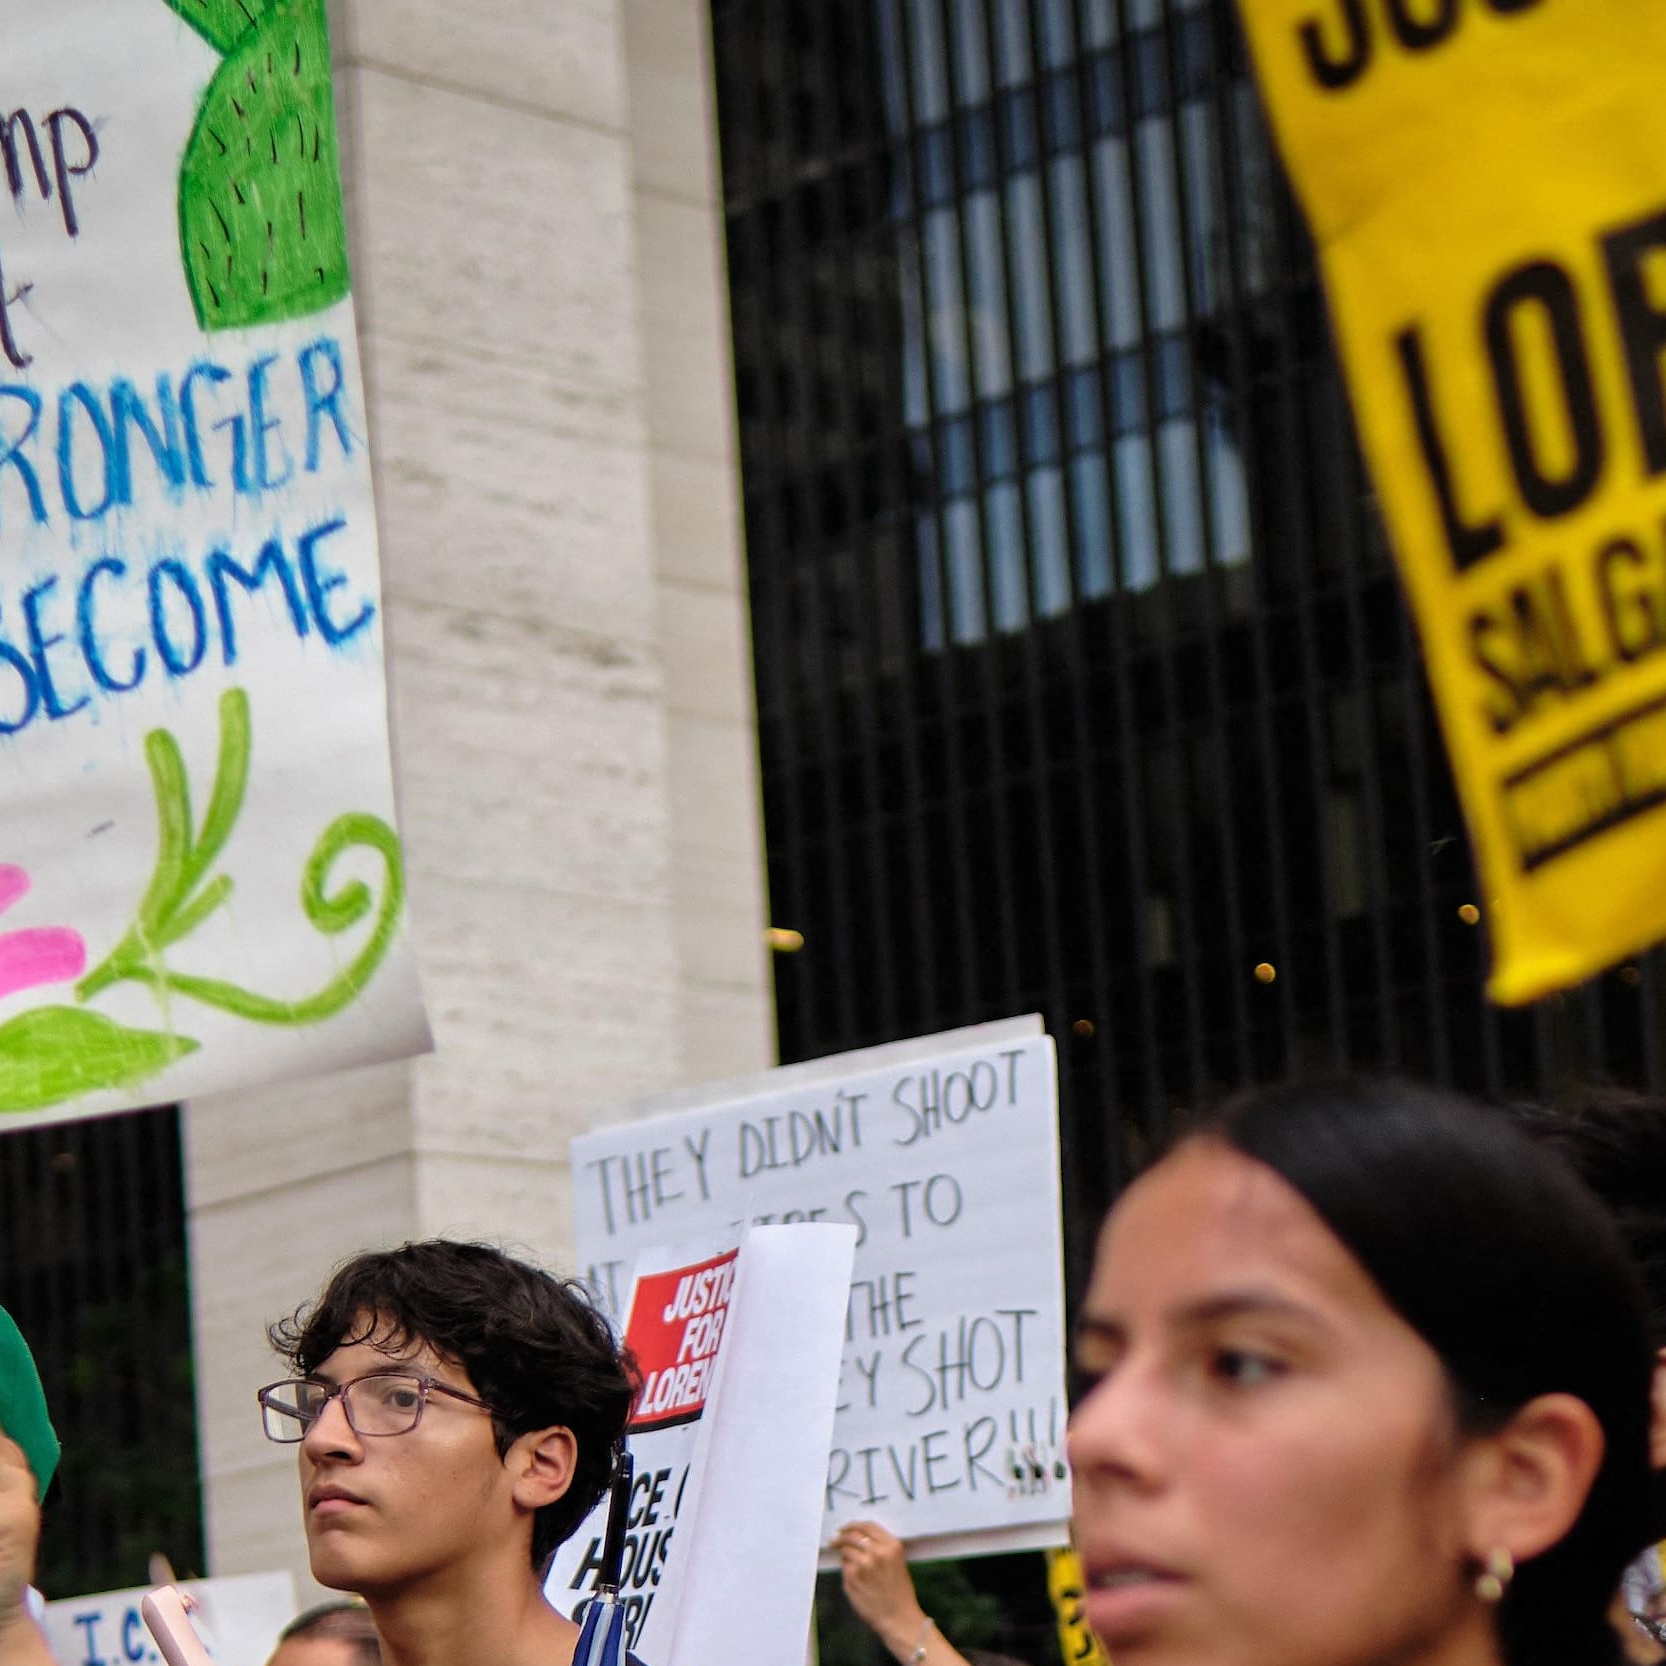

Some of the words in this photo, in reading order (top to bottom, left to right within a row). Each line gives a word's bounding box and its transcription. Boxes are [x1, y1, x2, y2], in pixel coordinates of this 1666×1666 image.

[586, 1128, 716, 1236] THEY
[892, 1050, 1026, 1146] SHOOT
[890, 1173, 963, 1239] TO
[676, 1308, 726, 1364] FOR
[901, 1308, 1039, 1417] SHOT
